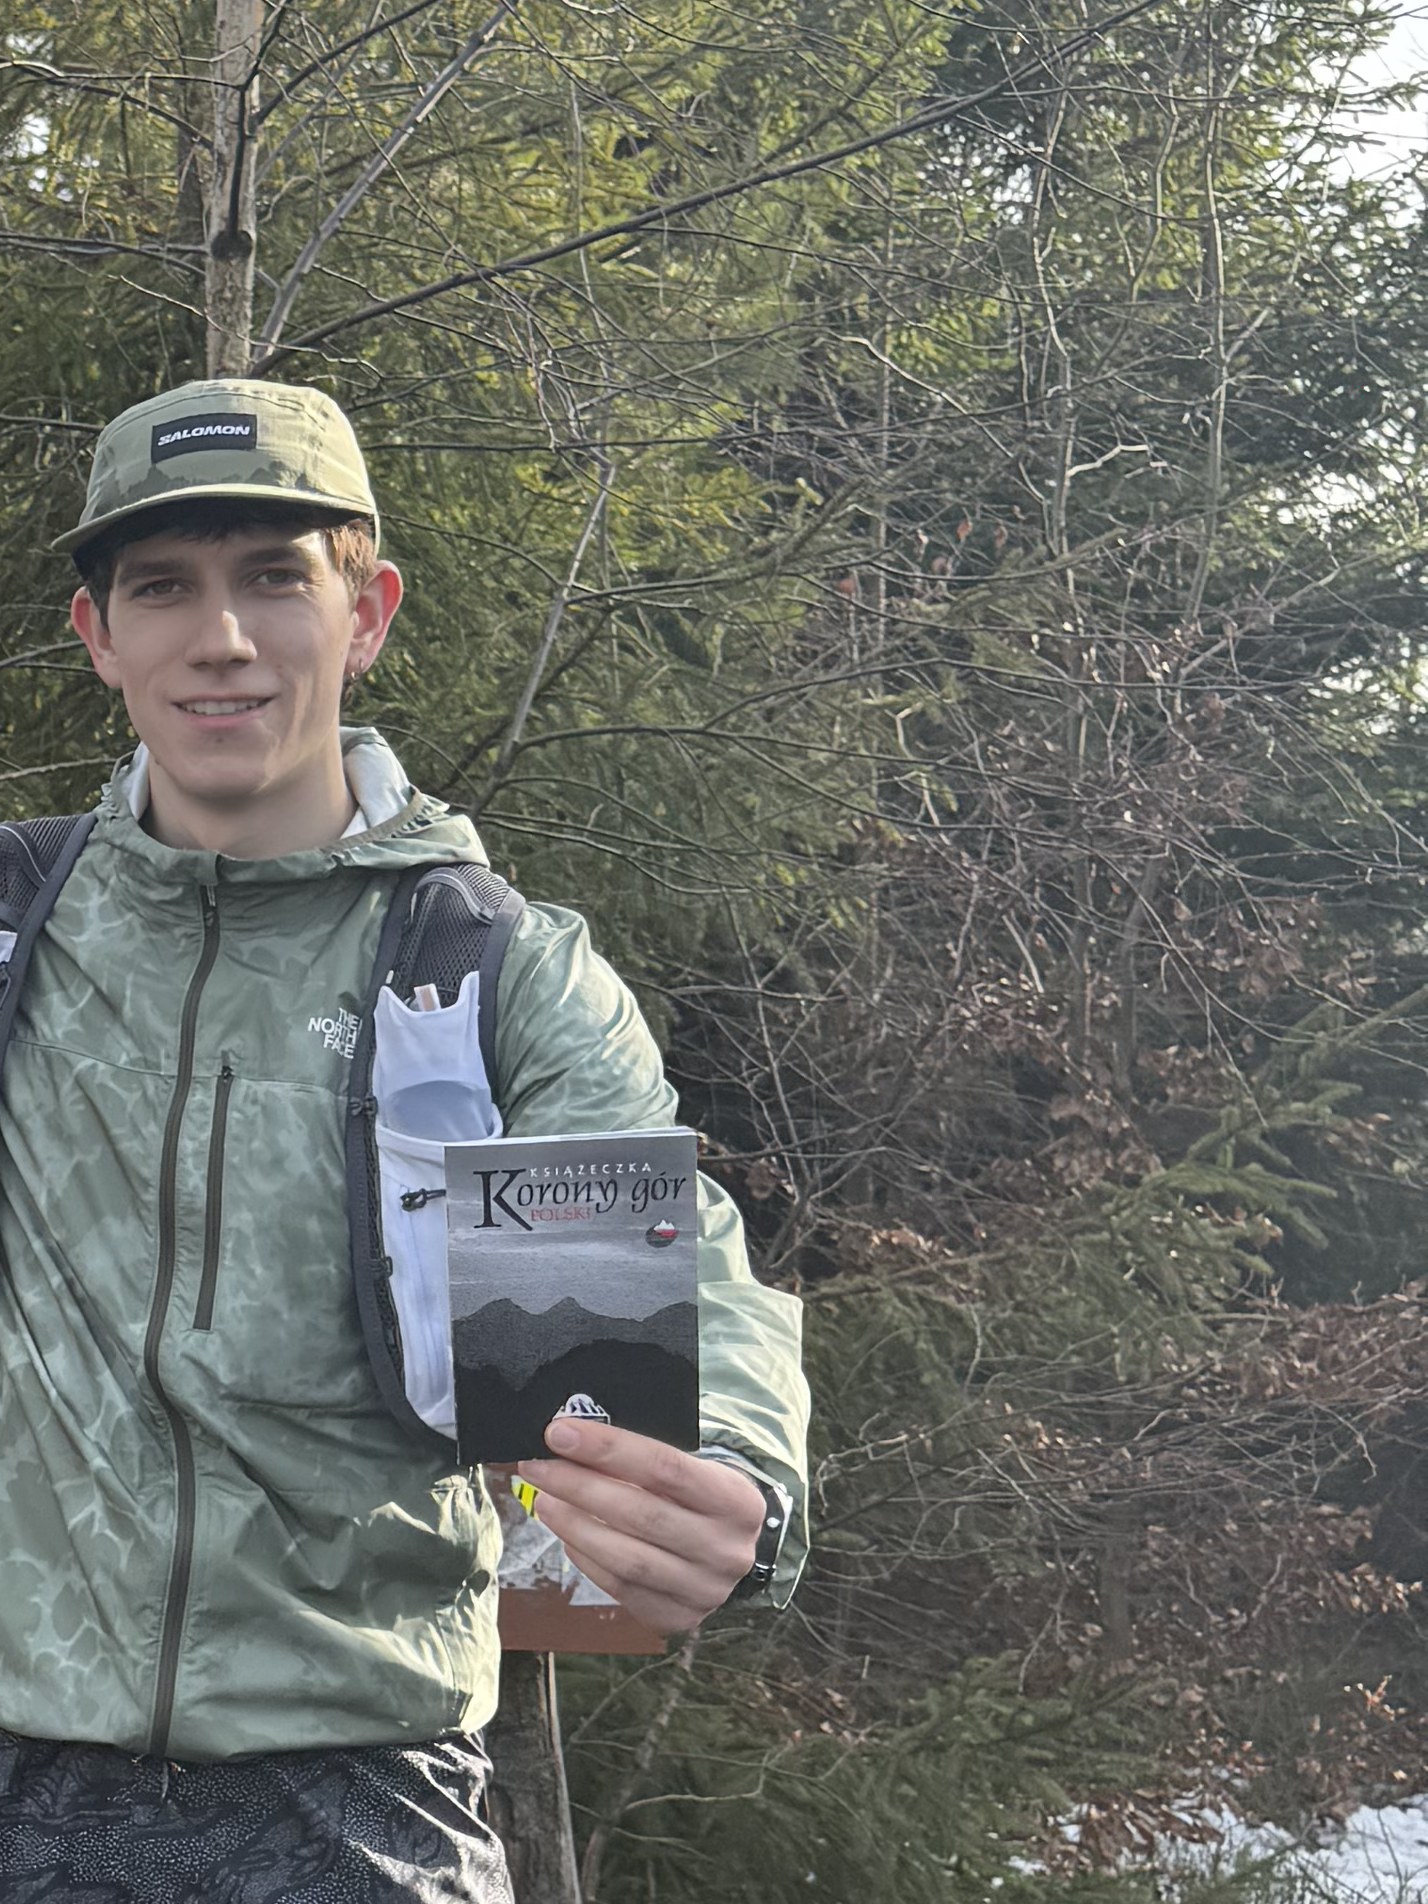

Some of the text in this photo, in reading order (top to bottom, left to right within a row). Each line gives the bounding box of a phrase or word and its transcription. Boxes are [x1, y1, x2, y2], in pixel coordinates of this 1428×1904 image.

[157, 425, 251, 446] SALOMON
[307, 1016, 358, 1047] NORTH
[339, 1007, 360, 1031] THE
[323, 1033, 355, 1059] FACE
[473, 1168, 687, 1232] Korony gór
